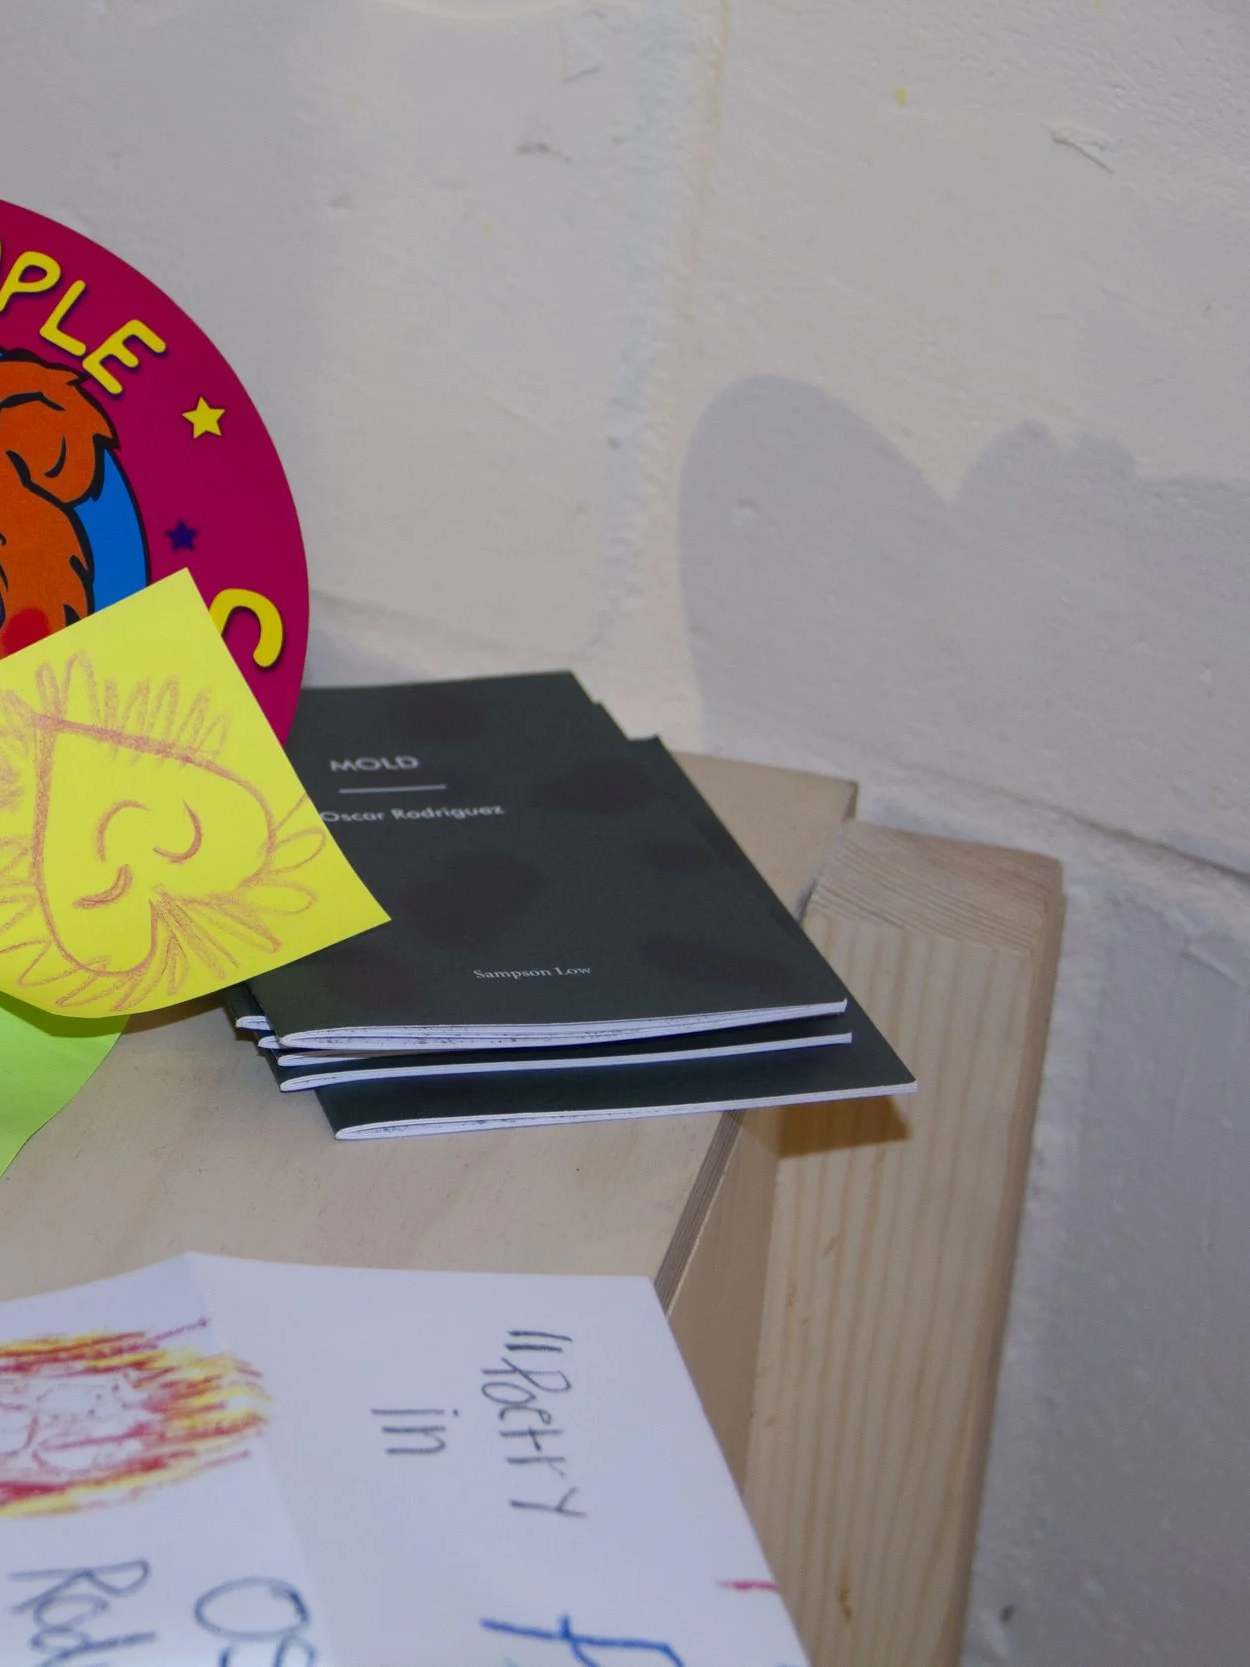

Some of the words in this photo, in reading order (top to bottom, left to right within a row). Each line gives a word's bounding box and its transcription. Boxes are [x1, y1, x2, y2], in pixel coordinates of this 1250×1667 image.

[329, 755, 420, 772] MOLD
[320, 809, 384, 823] Oscar
[391, 804, 505, 821] Rodriguez
[473, 968, 551, 980] Sampson
[554, 966, 591, 976] Low
[370, 1406, 459, 1456] in
